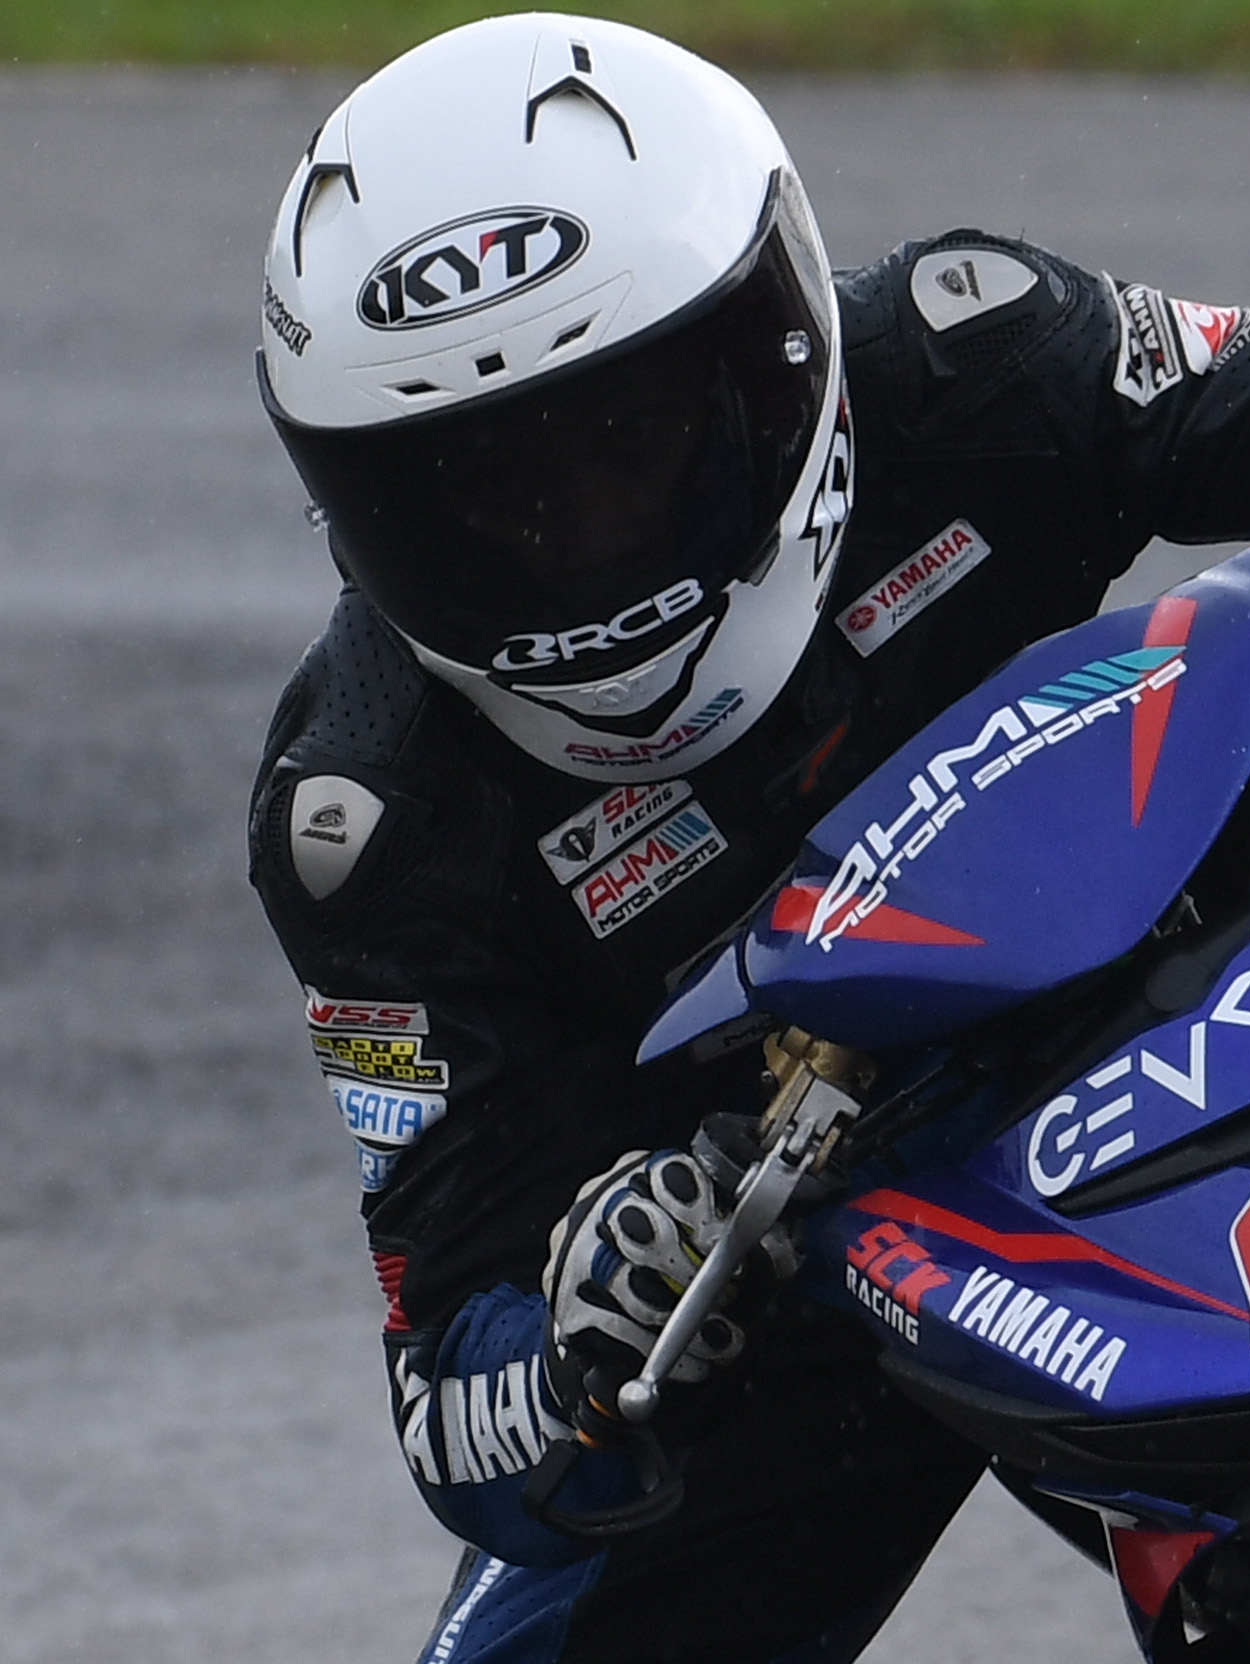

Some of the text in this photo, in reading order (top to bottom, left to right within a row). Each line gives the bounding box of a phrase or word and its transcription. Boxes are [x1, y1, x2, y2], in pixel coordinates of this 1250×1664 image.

[373, 214, 553, 325] KYT
[871, 528, 973, 610] YAMAHA
[561, 578, 704, 661] RCB
[611, 786, 674, 840] RACING
[805, 699, 1062, 945] AHM
[819, 792, 967, 953] MOTOR
[971, 658, 1188, 791] SPORTS
[583, 838, 680, 919] AHM
[597, 836, 720, 933] MOTOR SPORTS
[346, 1088, 423, 1137] SATA
[845, 1263, 920, 1347] RACING
[846, 1221, 952, 1316] SCK
[948, 1265, 1128, 1402] YAMAHA
